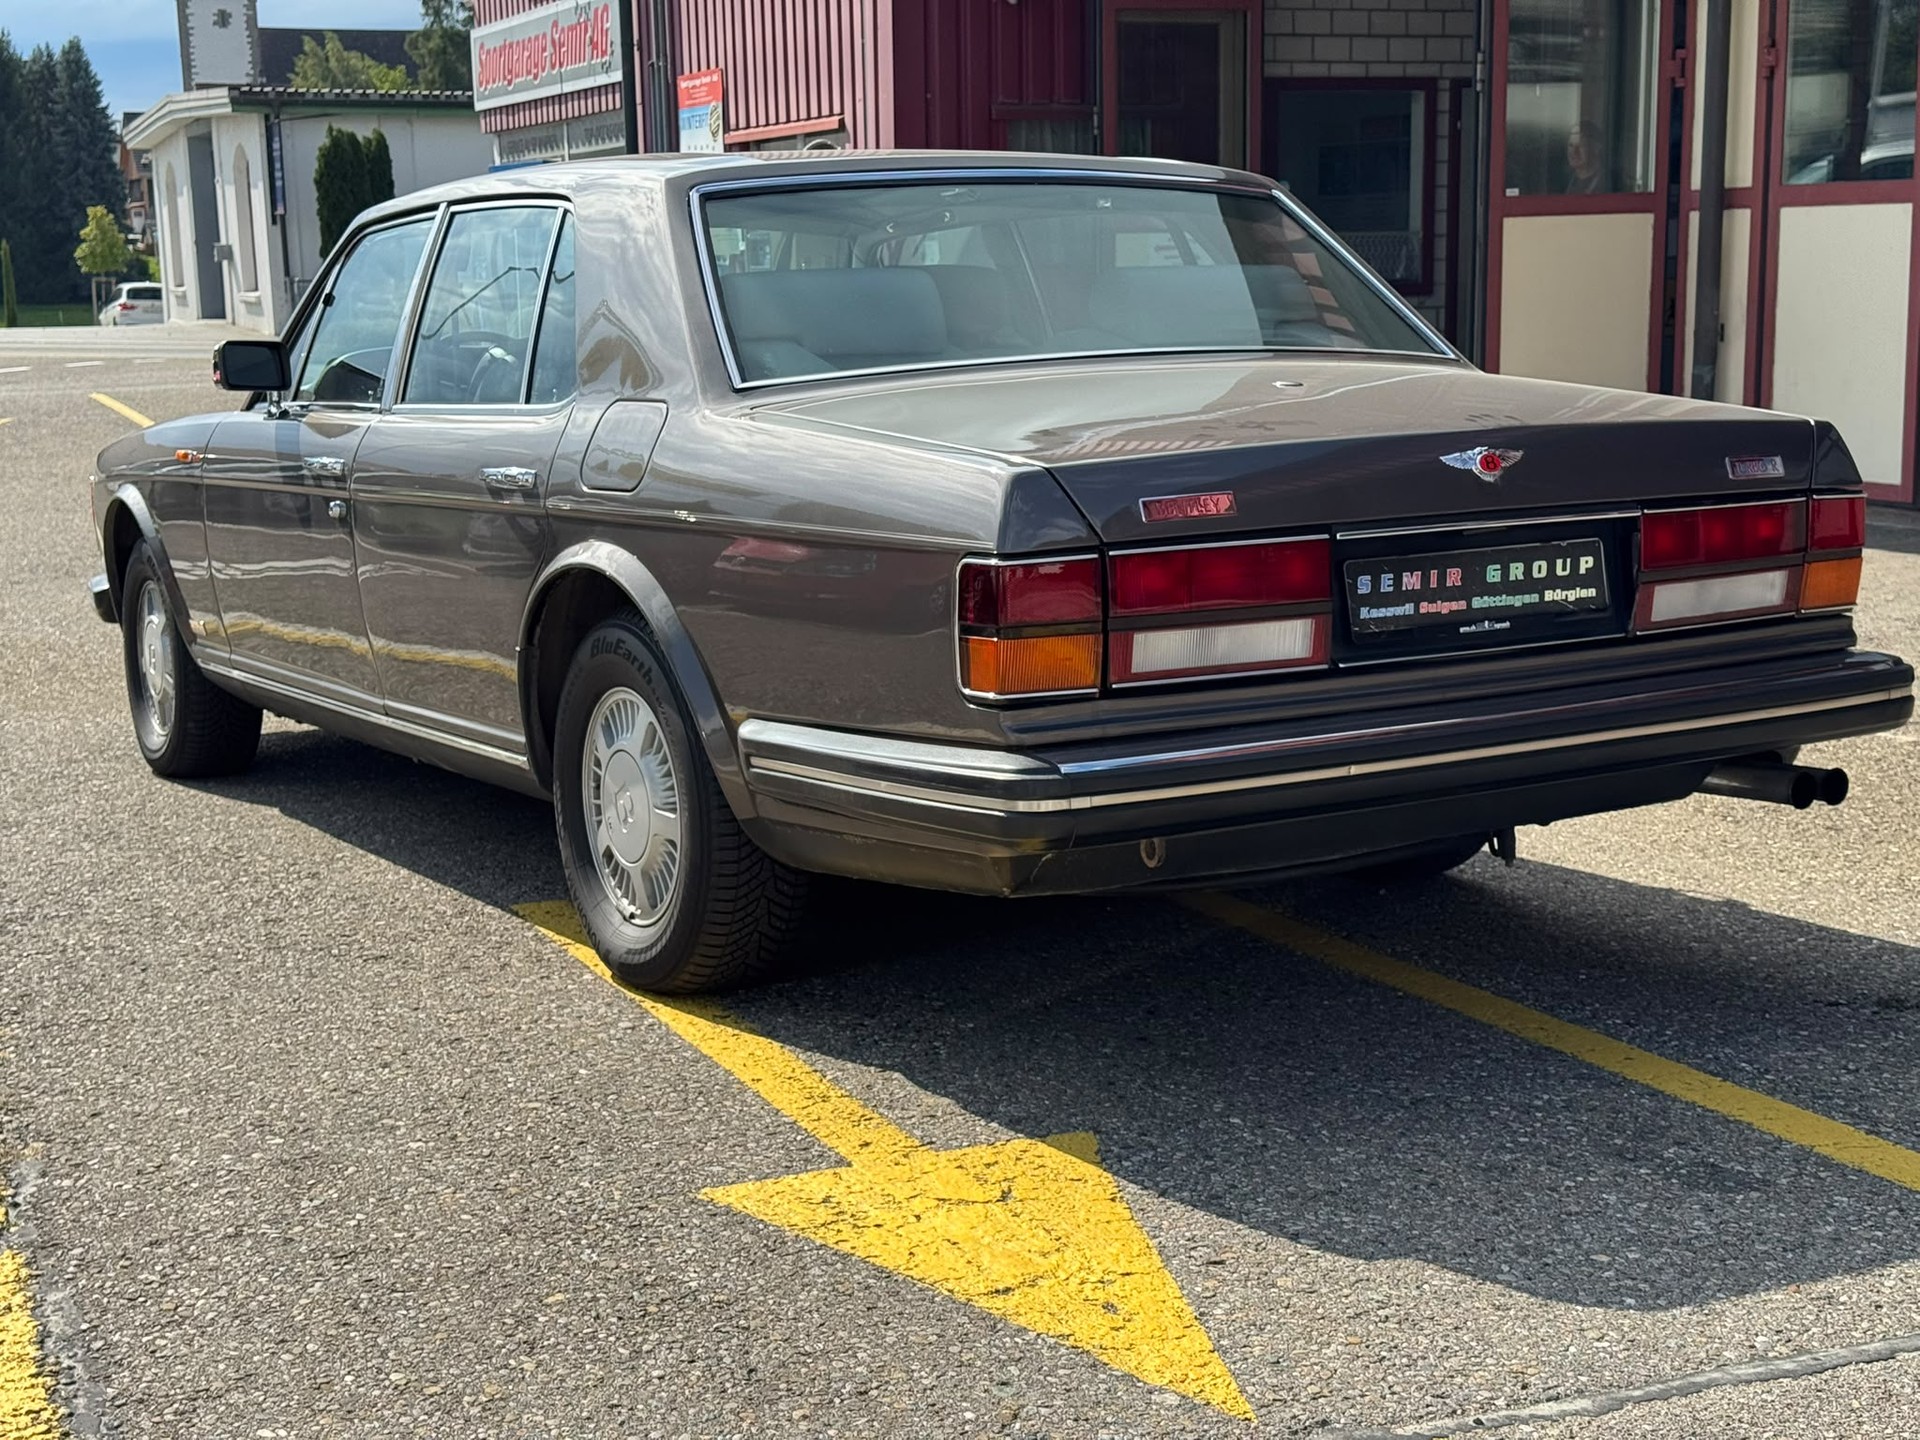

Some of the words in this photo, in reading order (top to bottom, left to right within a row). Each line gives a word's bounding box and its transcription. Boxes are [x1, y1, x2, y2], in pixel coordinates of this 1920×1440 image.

[478, 32, 548, 93] Sportgarage
[550, 11, 591, 73] Semir
[591, 3, 611, 64] AG
[1155, 496, 1220, 516] BENTLEY
[1357, 567, 1462, 595] SEMIR
[1486, 556, 1594, 583] GROUP
[590, 635, 653, 685] BluEarth
